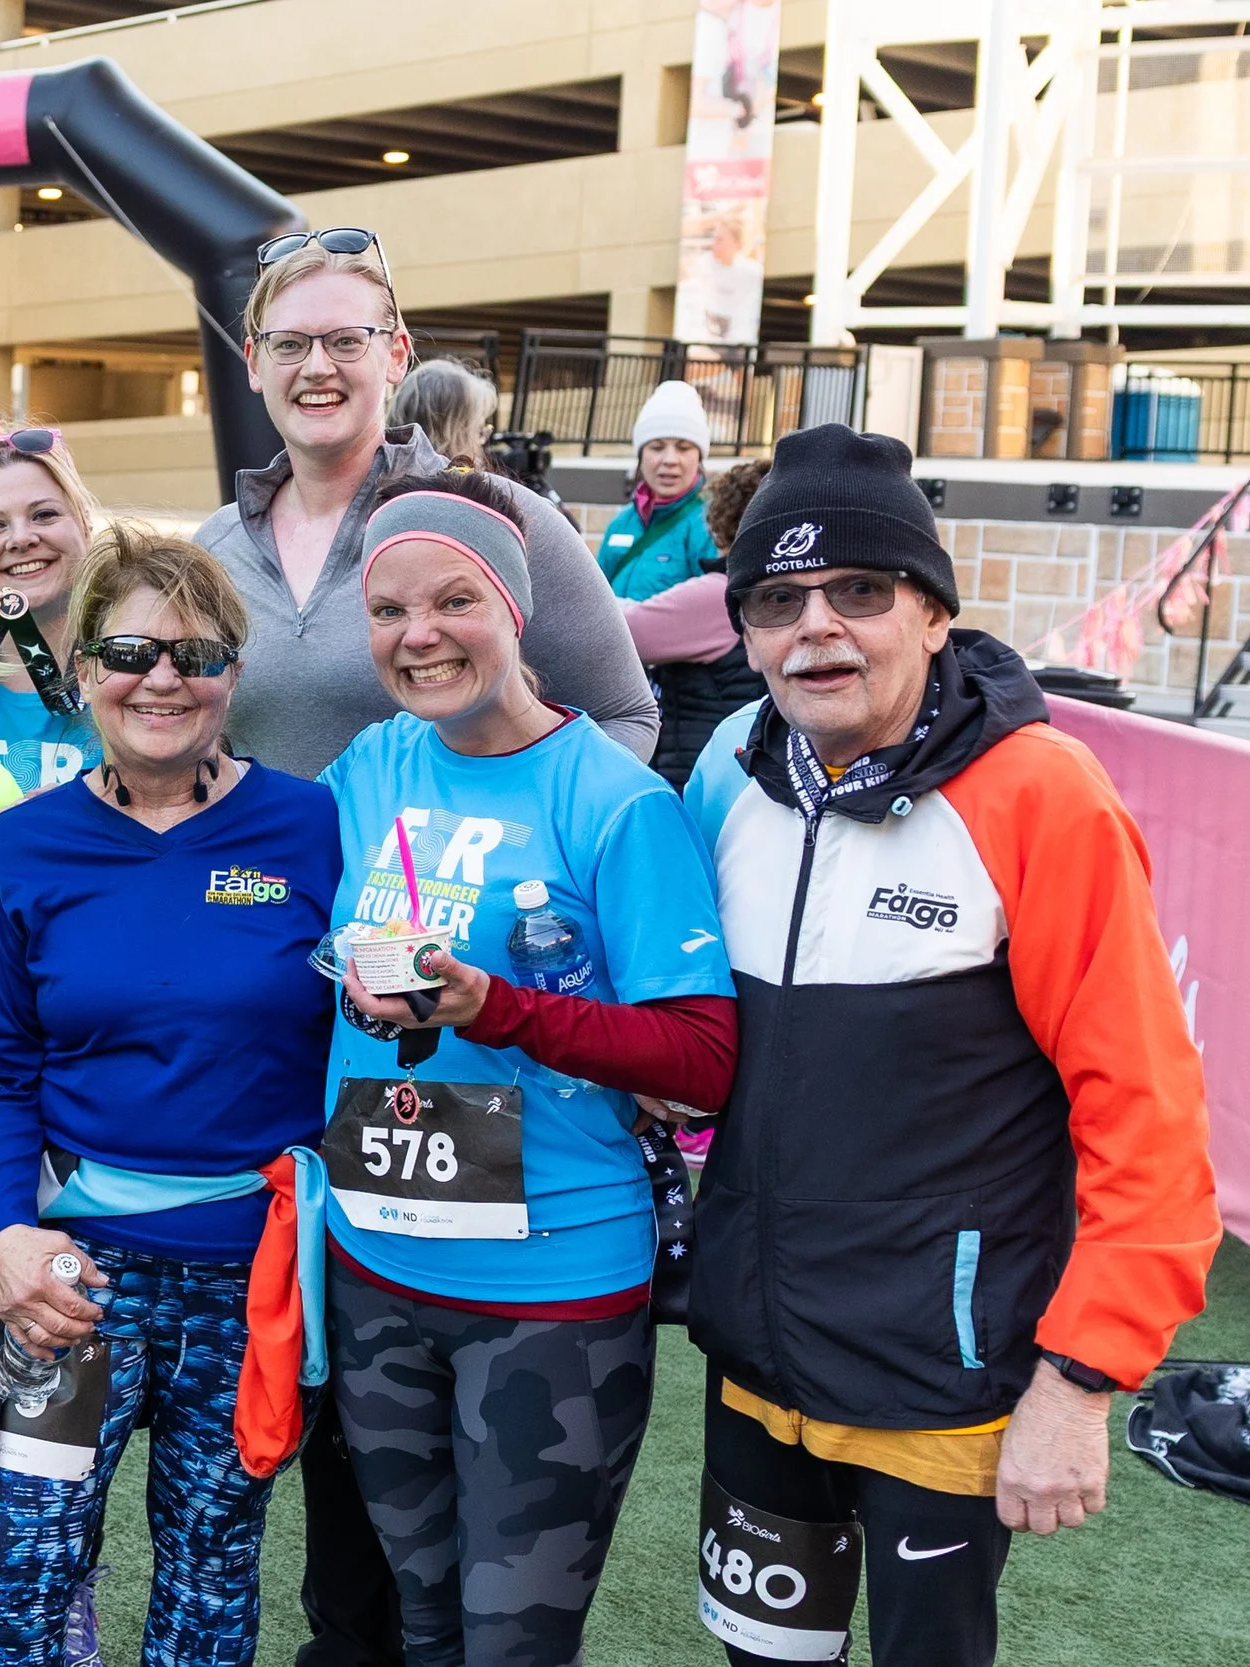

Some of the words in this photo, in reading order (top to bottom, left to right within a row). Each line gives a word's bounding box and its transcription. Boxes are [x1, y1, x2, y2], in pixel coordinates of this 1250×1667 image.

[766, 557, 828, 573] FOOTBALL
[210, 870, 286, 902] Fargo
[354, 885, 475, 941] RUNNER
[868, 912, 906, 921] MARATHON
[869, 887, 958, 929] Fargo
[559, 961, 592, 992] AQUAF
[362, 1126, 459, 1183] 578
[403, 1212, 418, 1222] ND
[742, 1521, 782, 1543] BIOGirls
[701, 1527, 807, 1610] 480
[722, 1618, 738, 1633] ND
